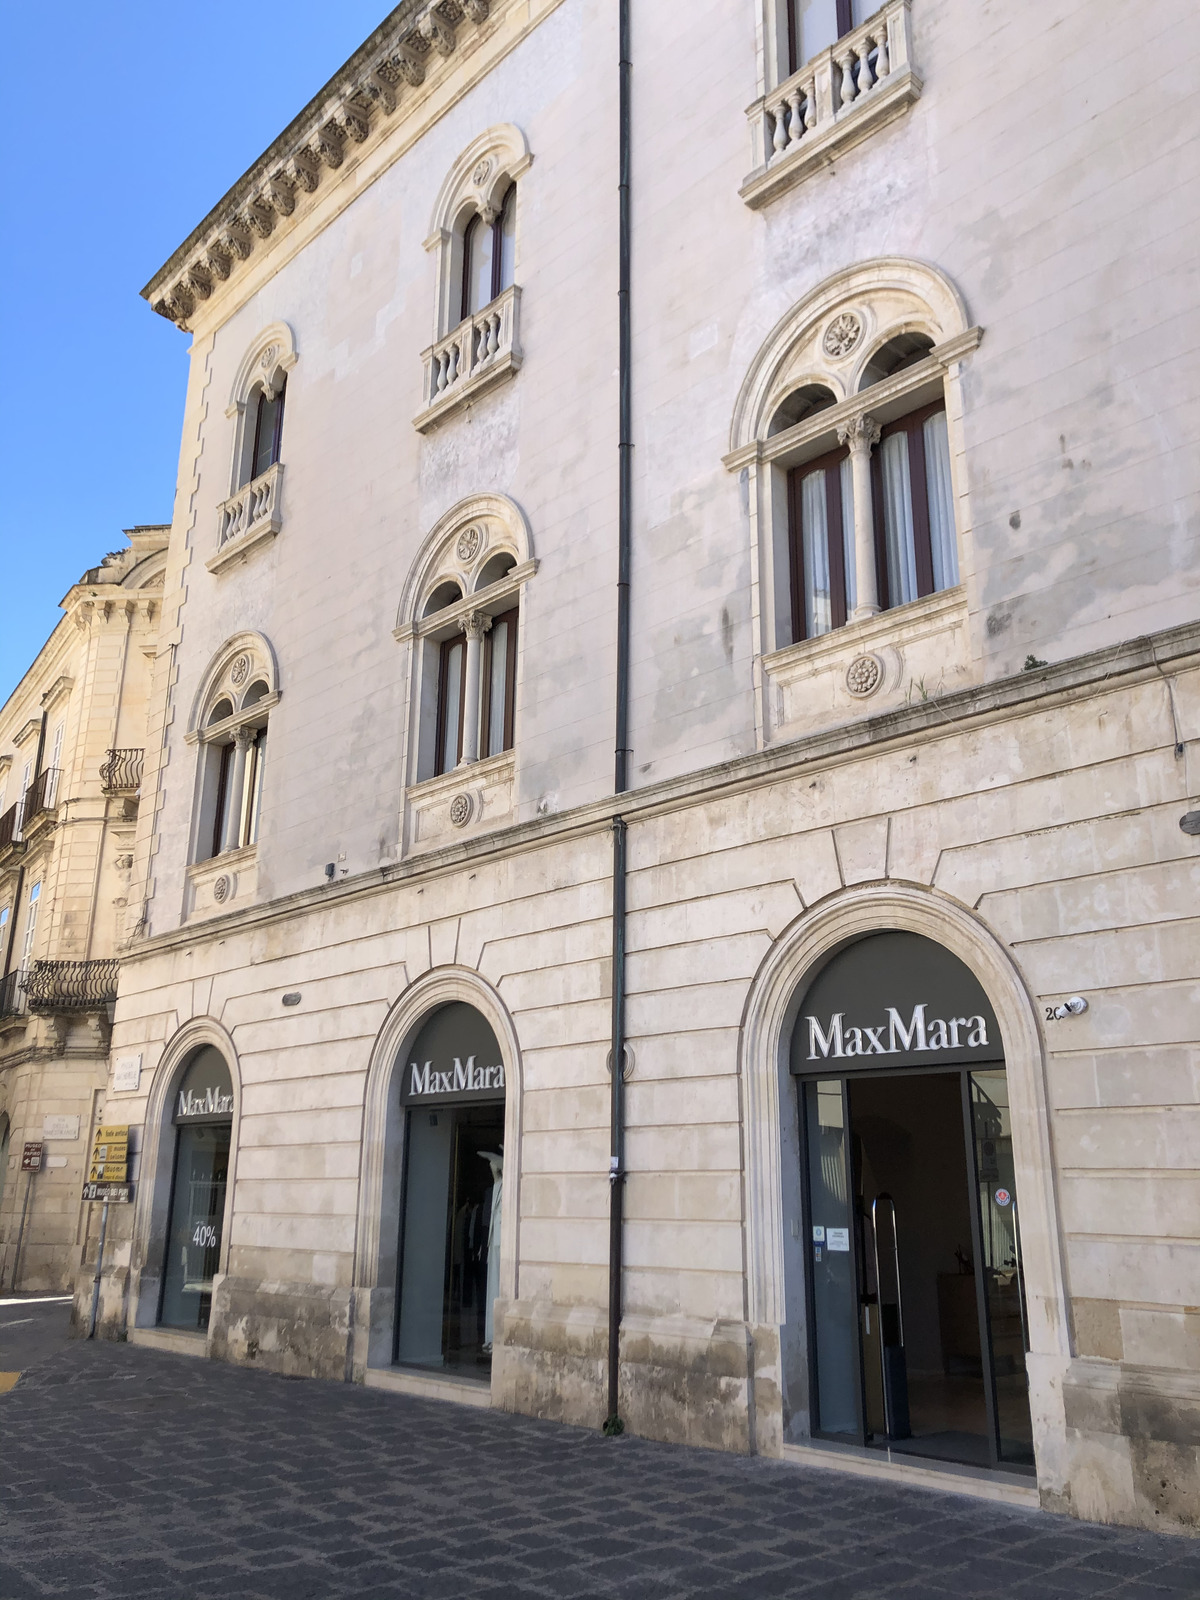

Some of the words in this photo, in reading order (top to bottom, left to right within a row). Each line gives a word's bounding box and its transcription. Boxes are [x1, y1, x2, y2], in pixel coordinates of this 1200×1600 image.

[804, 1003, 990, 1061] MaxMara
[408, 1055, 505, 1097] MaxMara
[192, 1225, 217, 1248] 40%
